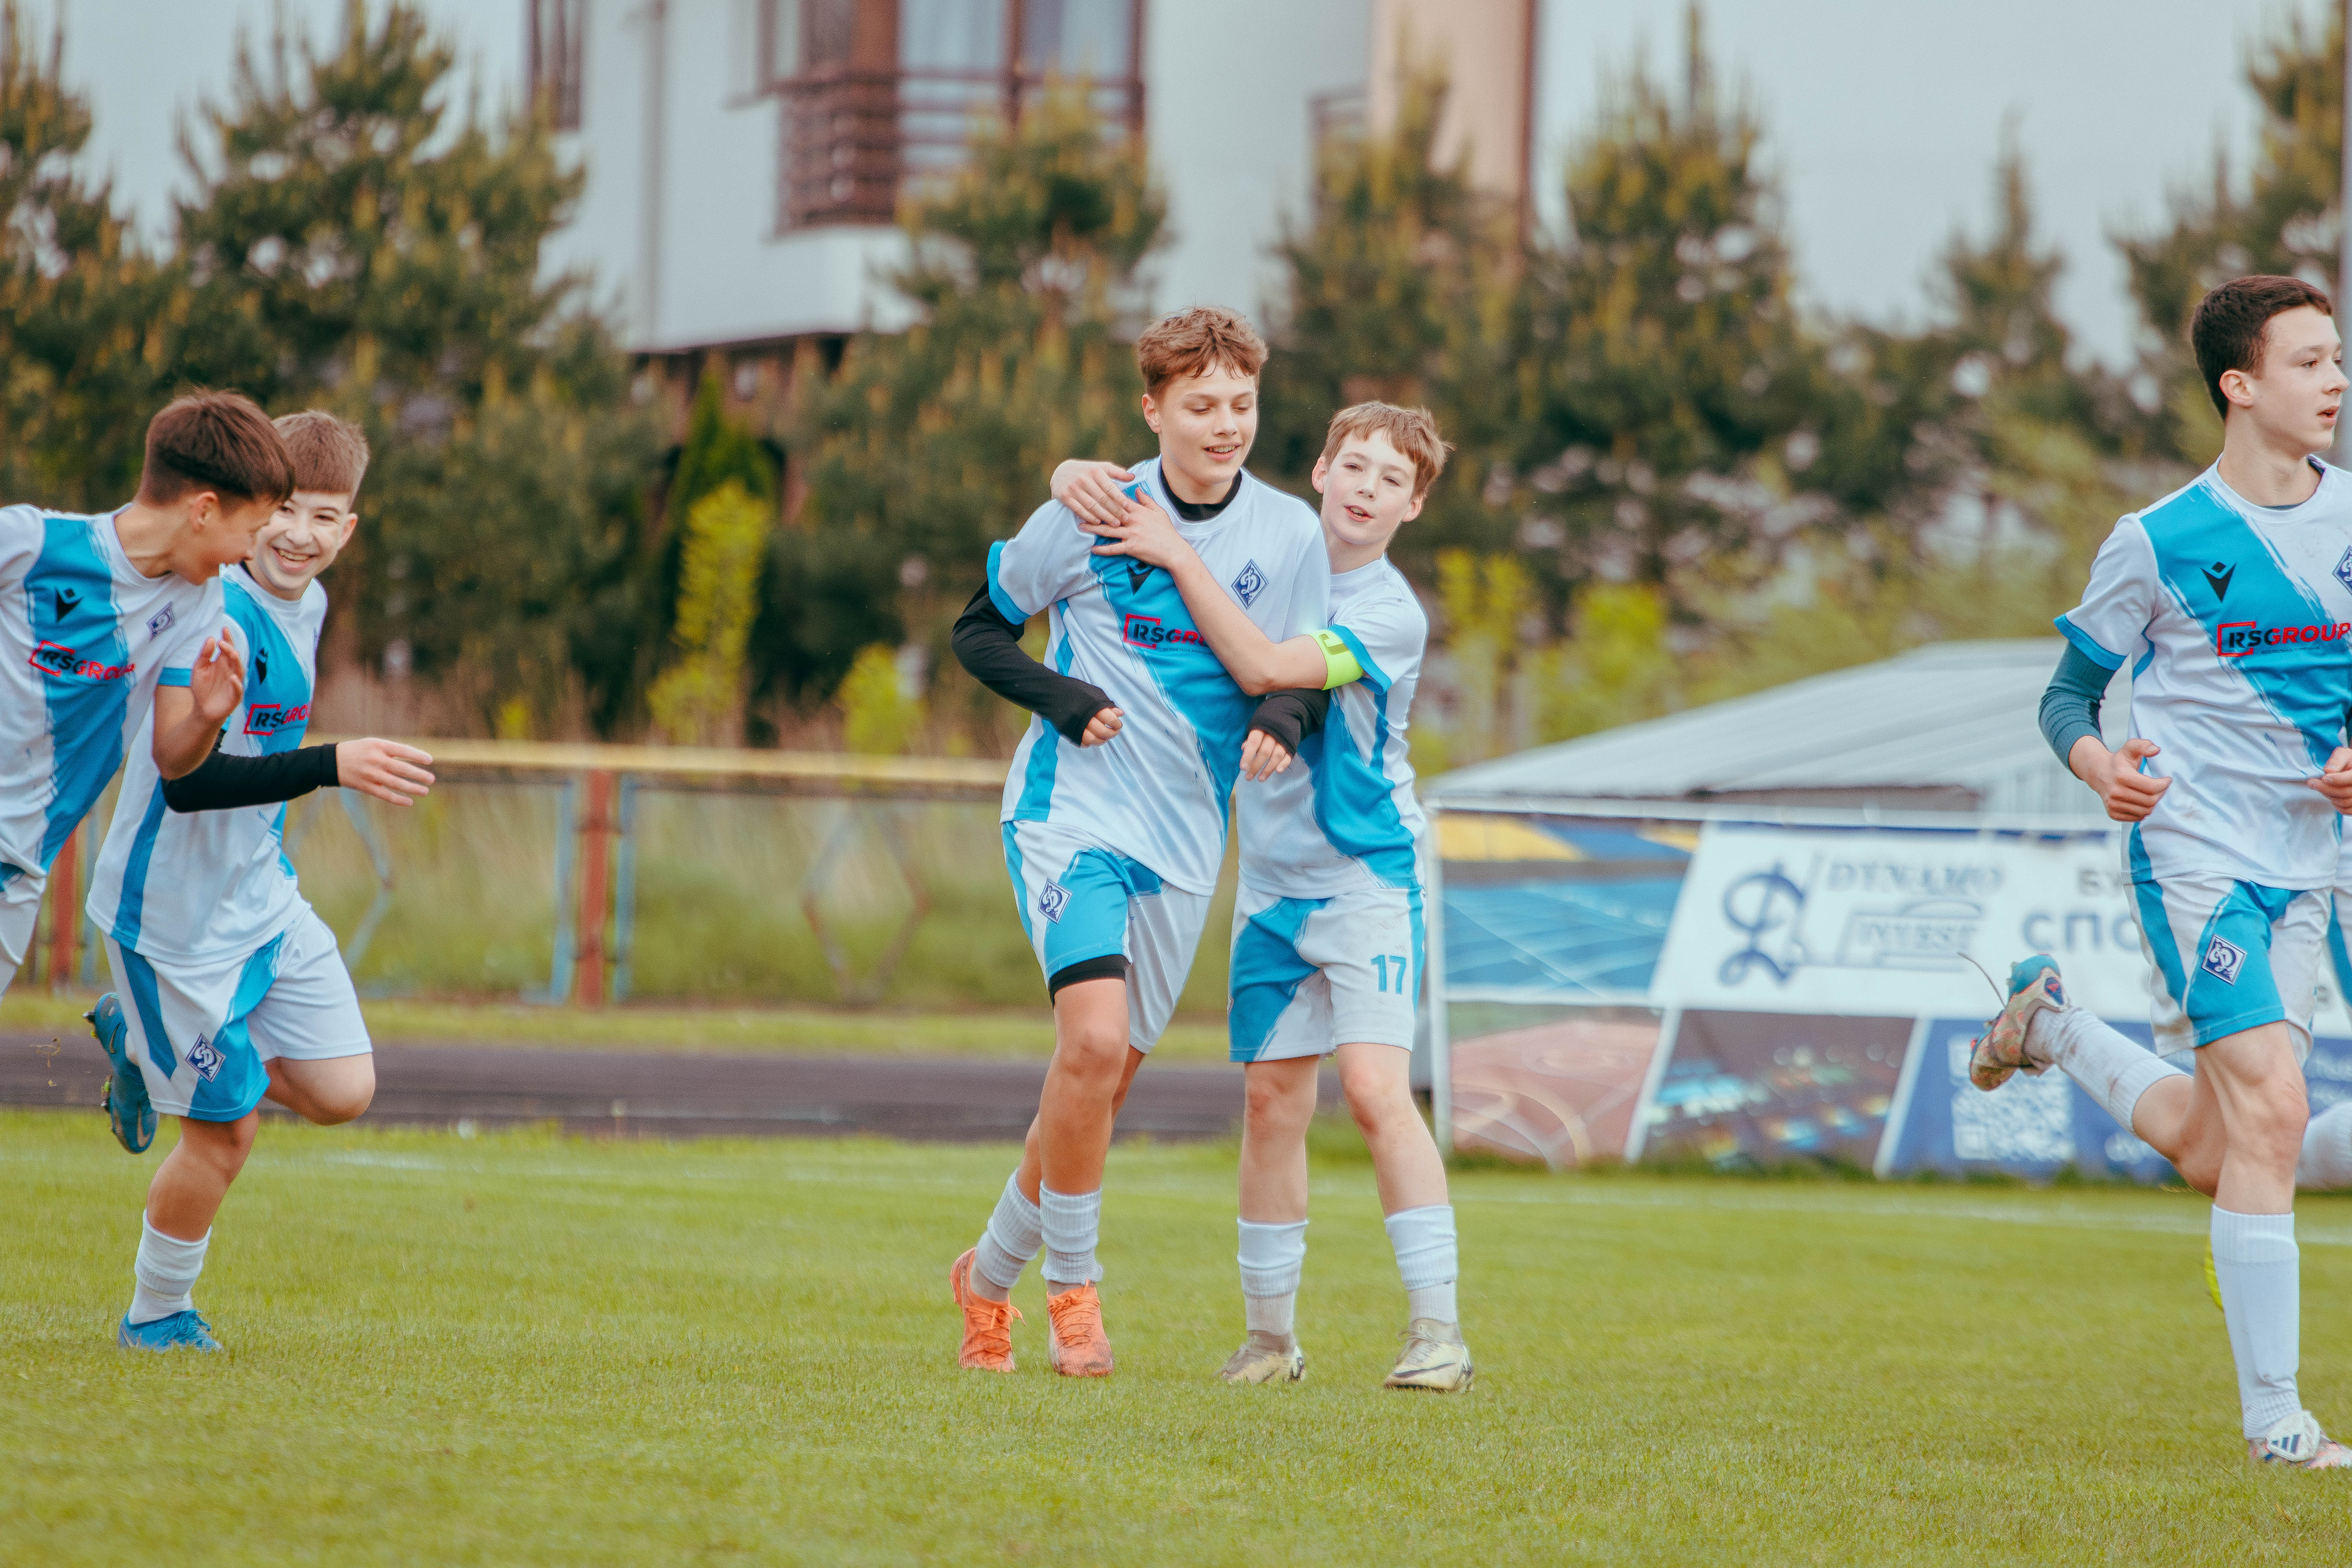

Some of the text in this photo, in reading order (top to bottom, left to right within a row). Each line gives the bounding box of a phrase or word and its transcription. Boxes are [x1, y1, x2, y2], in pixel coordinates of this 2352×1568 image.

[1133, 624, 1205, 646] RSGR
[2229, 622, 2351, 648] RSGROUP
[2021, 910, 2141, 952] СПО
[1371, 954, 1406, 995] 17
